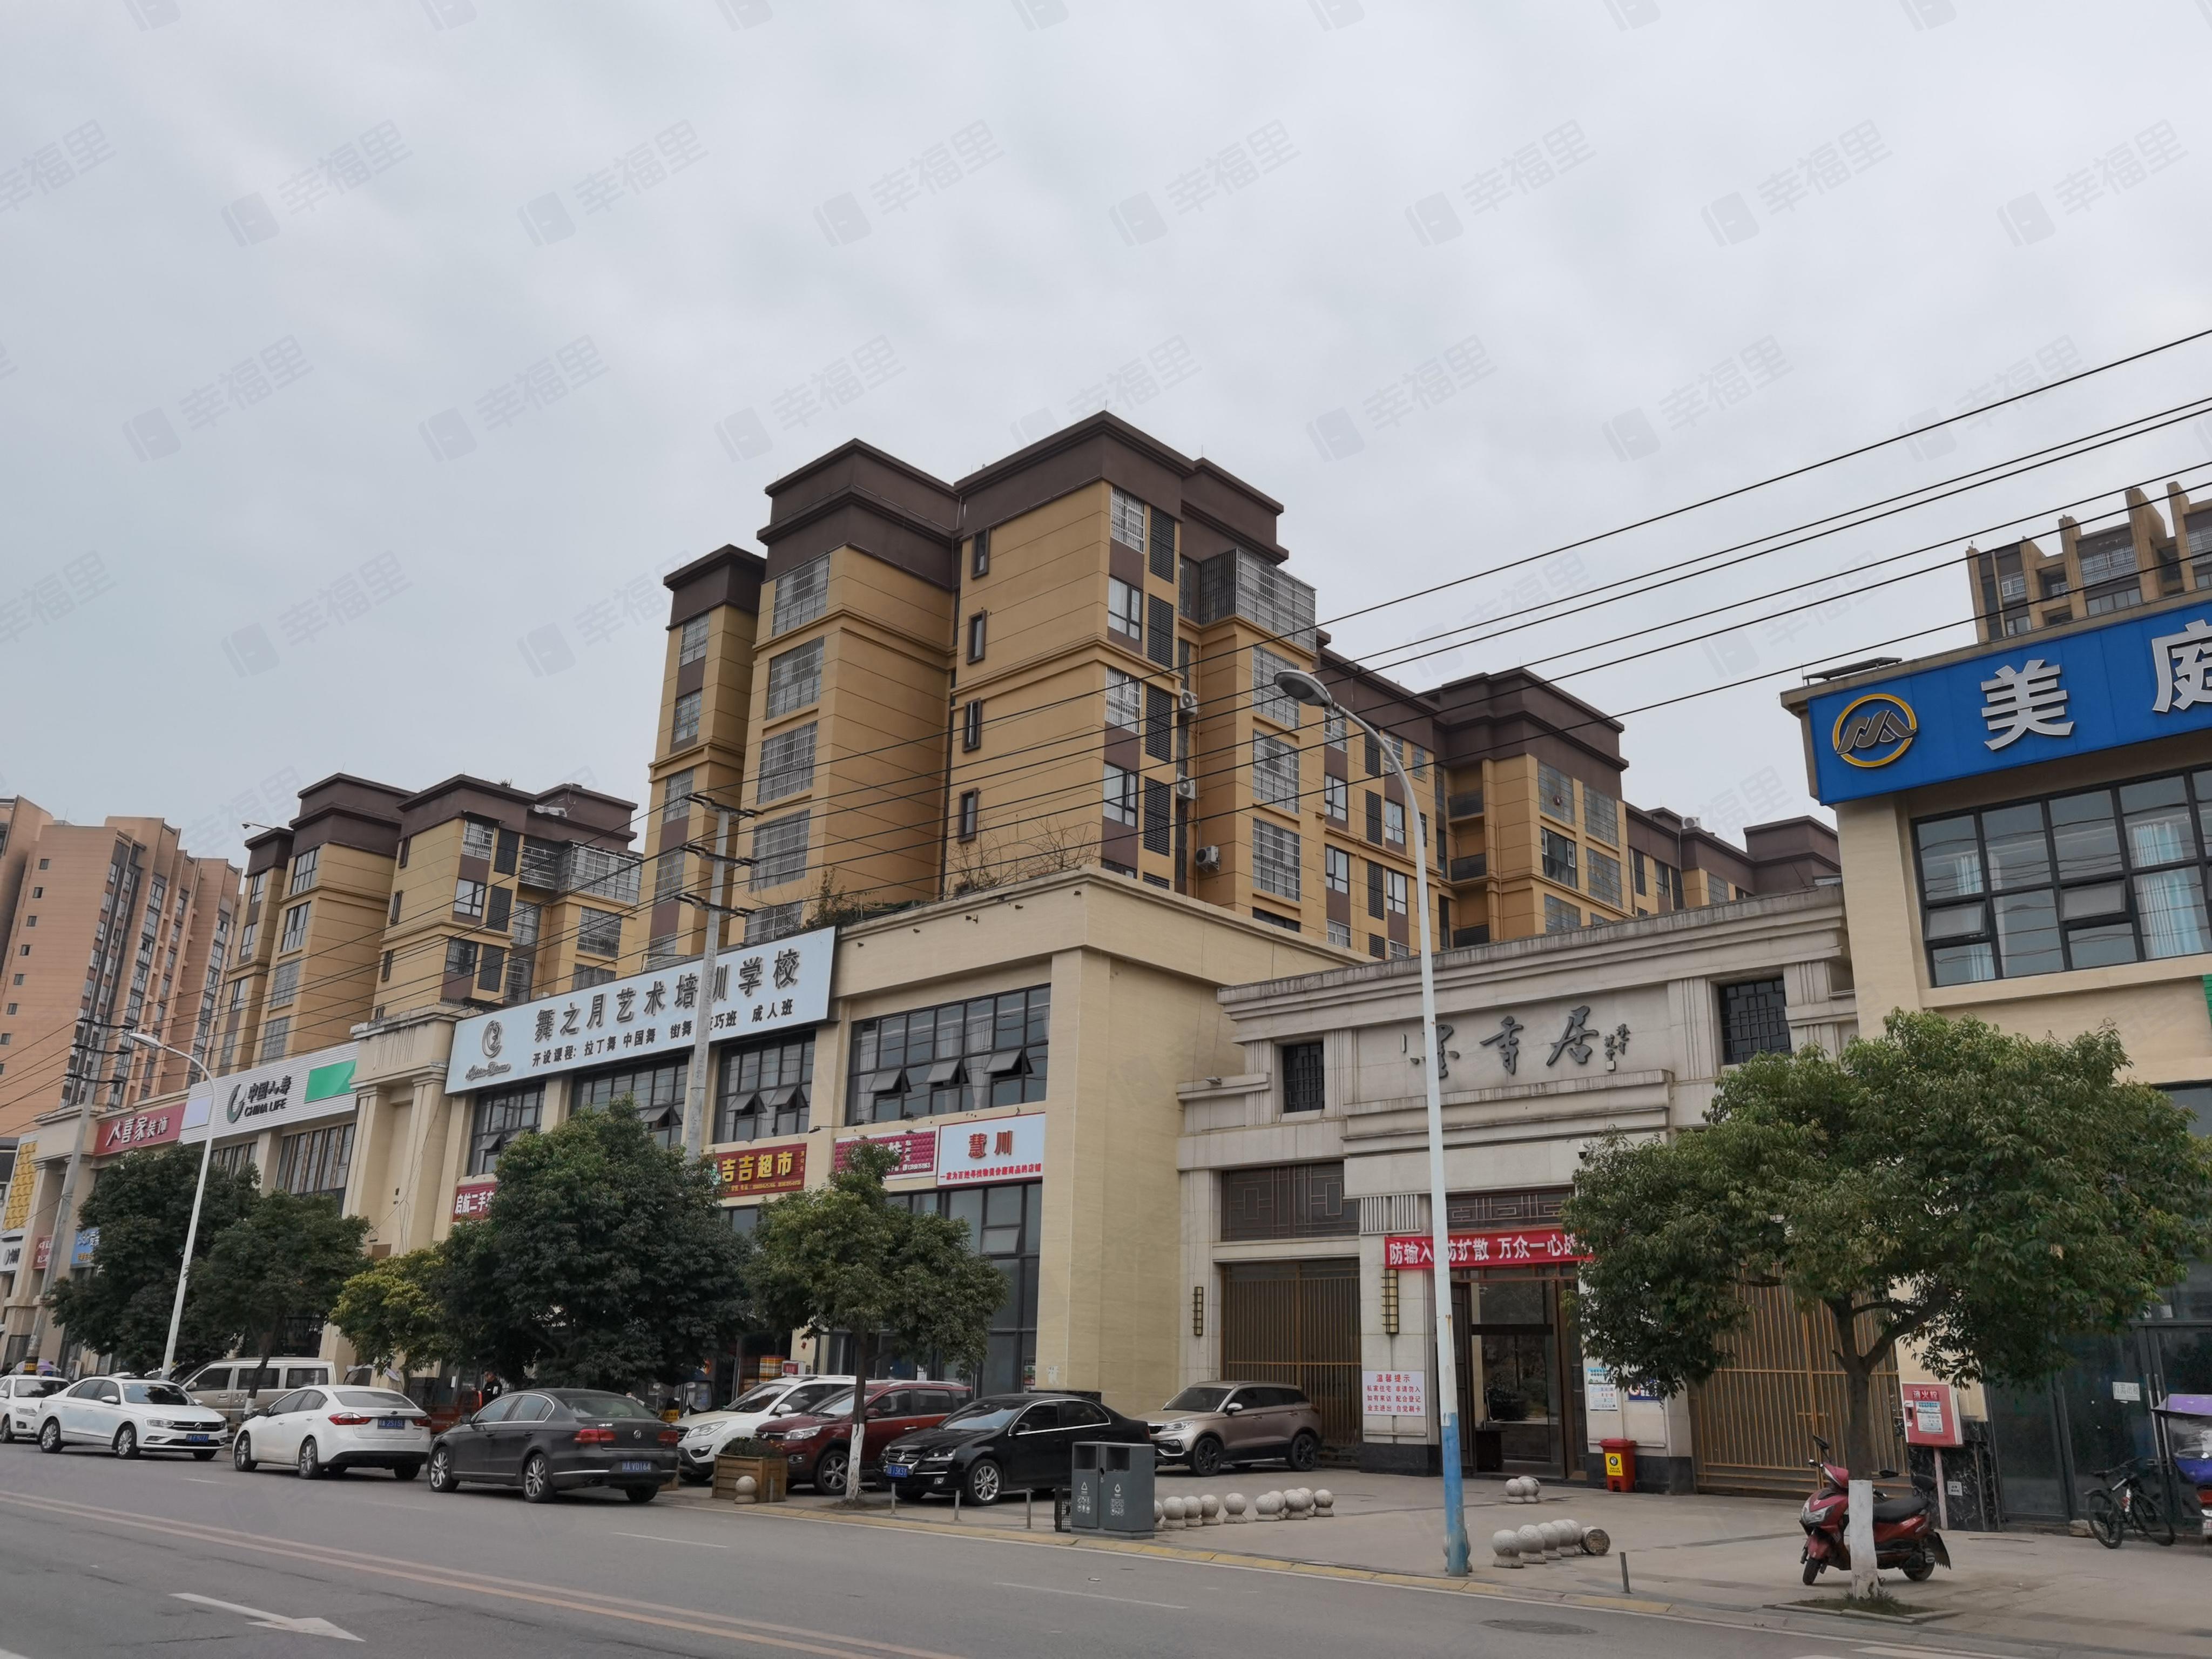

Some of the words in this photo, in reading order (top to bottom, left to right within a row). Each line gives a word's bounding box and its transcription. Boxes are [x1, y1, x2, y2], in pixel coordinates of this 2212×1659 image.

[535, 948, 800, 1042] 舞之月艺术培训学校
[584, 1036, 617, 1056] 拉丁舞
[623, 1028, 656, 1048] 中国舞
[670, 1021, 692, 1039] 街舞
[752, 999, 793, 1022] 成人班
[247, 1075, 292, 1103] 中国人寿
[245, 1103, 268, 1117] CHINA
[269, 1098, 288, 1112] LIFE
[968, 1130, 1013, 1158] 慧川
[721, 1151, 793, 1183] 吉吉超市
[1390, 1242, 1434, 1265] 防输入
[1498, 1232, 1592, 1259] 万众一心战
[1377, 1374, 1410, 1382] 温馨提示
[1913, 1390, 1938, 1400] 消火栓
